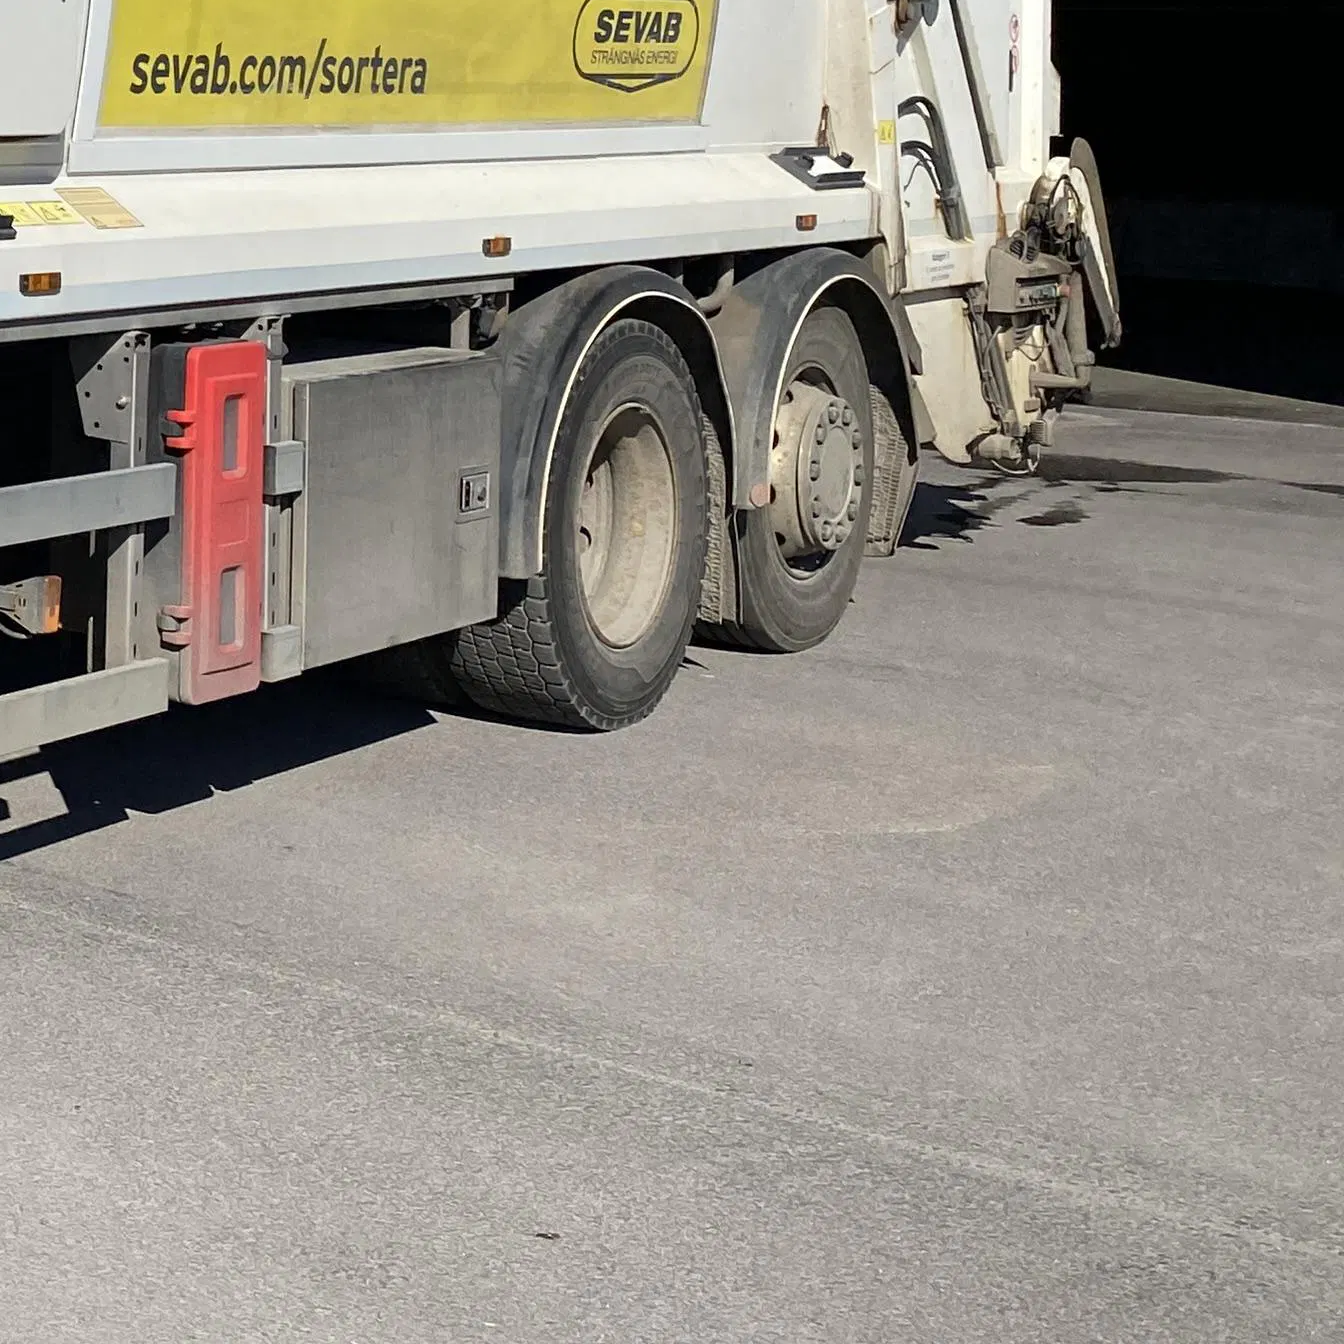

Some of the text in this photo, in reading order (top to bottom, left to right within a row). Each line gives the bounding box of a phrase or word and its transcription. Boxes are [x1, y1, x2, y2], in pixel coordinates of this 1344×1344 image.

[594, 9, 683, 43] SEVAB
[129, 38, 428, 99] sevab.com/sortera
[646, 50, 679, 65] ENERGI
